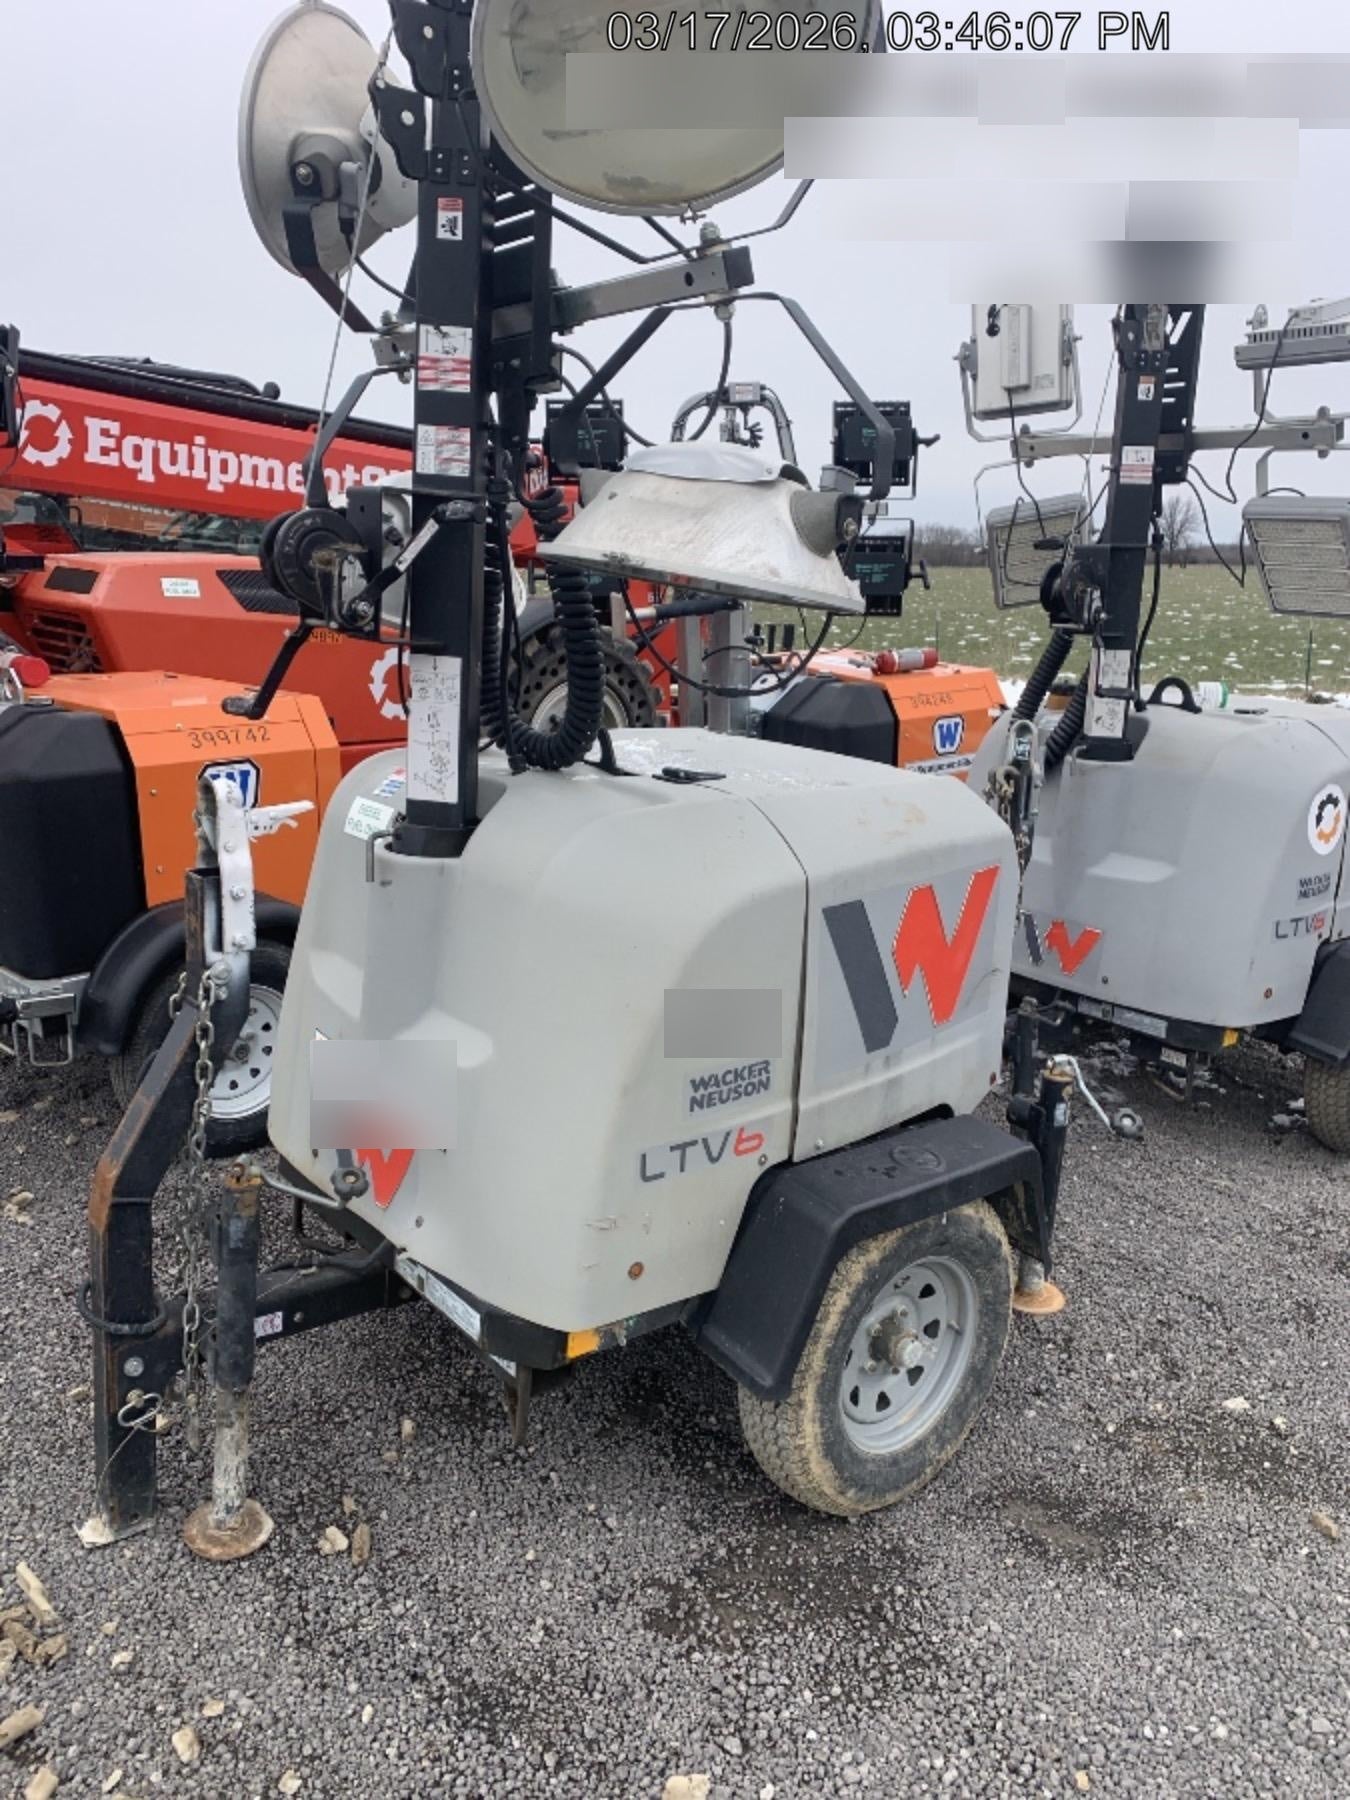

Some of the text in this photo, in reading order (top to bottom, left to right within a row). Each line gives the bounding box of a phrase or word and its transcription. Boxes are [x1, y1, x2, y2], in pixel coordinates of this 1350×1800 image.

[188, 725, 271, 749] 399742
[937, 721, 960, 749] W
[690, 1060, 770, 1093] WACKER
[690, 1076, 770, 1112] NEUSON
[640, 1126, 764, 1183] LTV6
